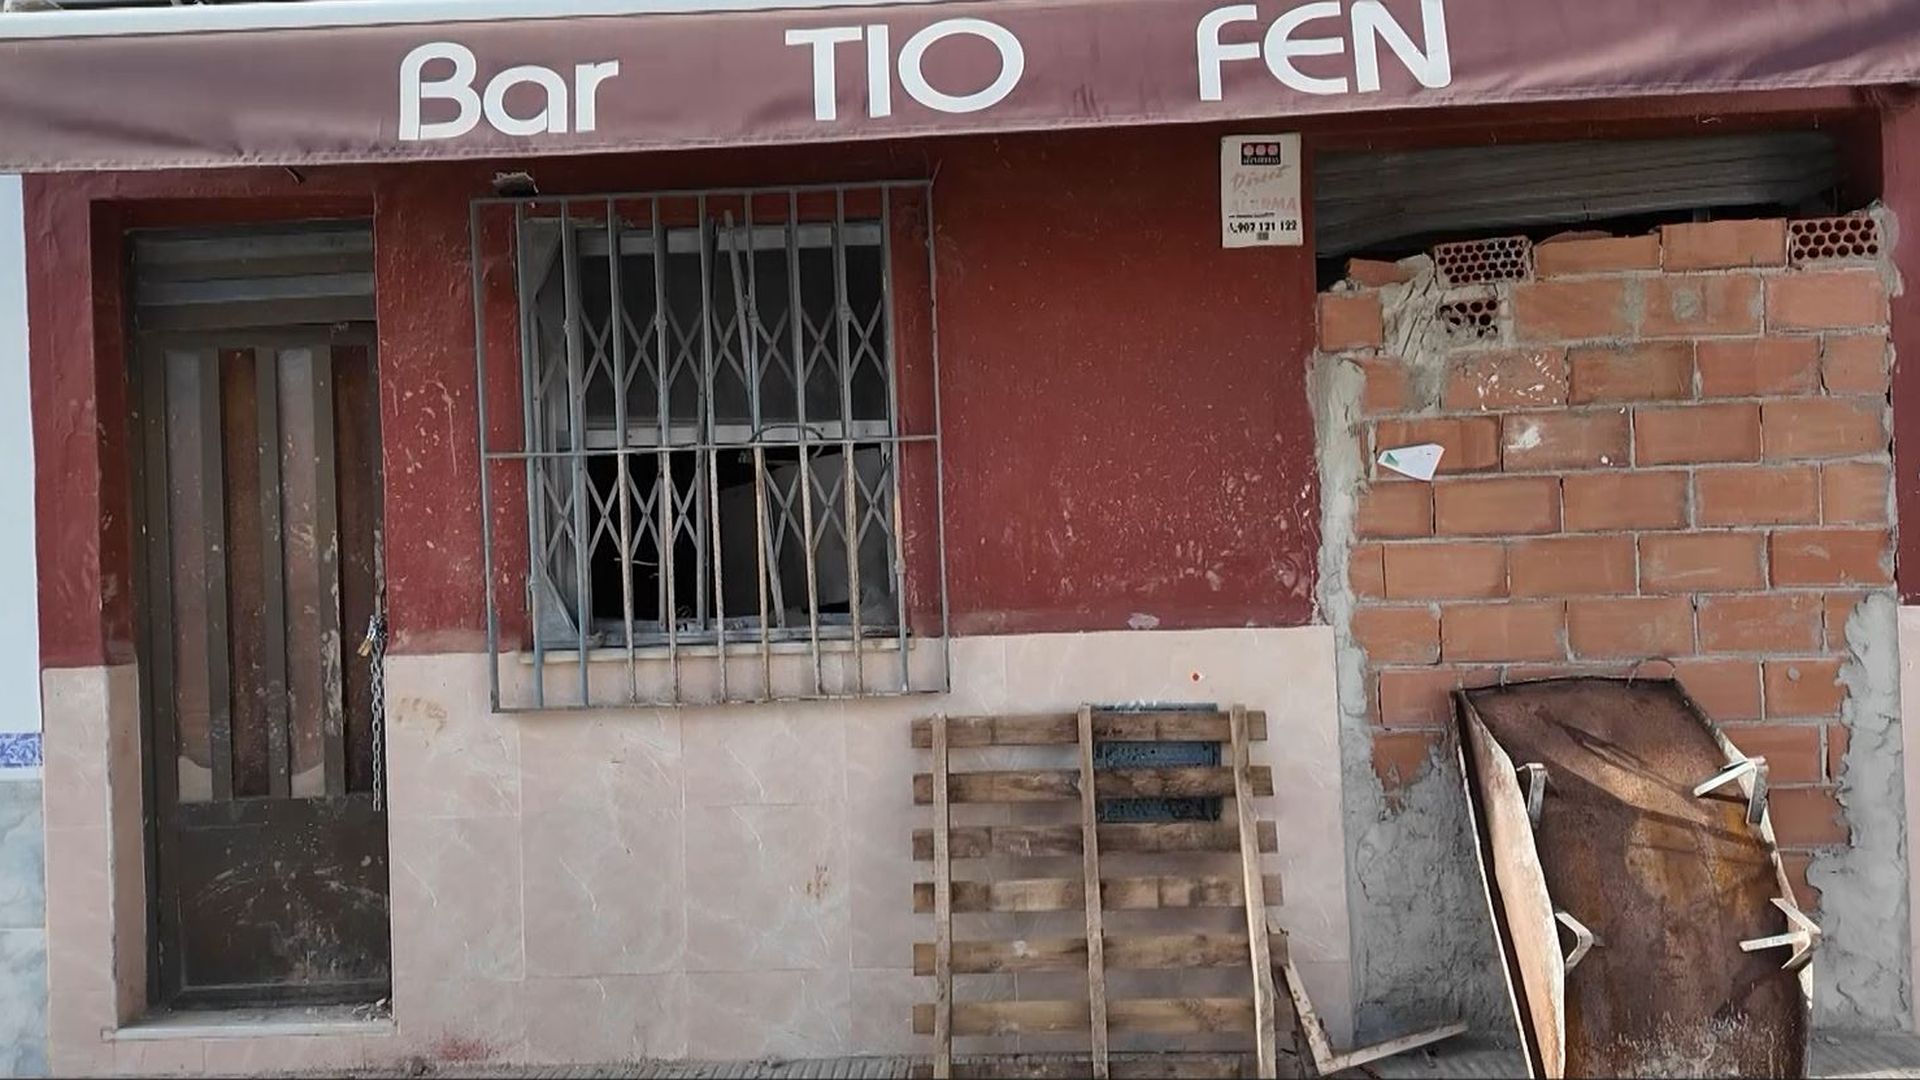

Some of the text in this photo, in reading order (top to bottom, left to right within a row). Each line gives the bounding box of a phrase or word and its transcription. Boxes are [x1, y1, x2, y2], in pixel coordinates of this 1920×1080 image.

[398, 0, 1452, 142] Bar TIO FEN
[1280, 219, 1298, 232] 122
